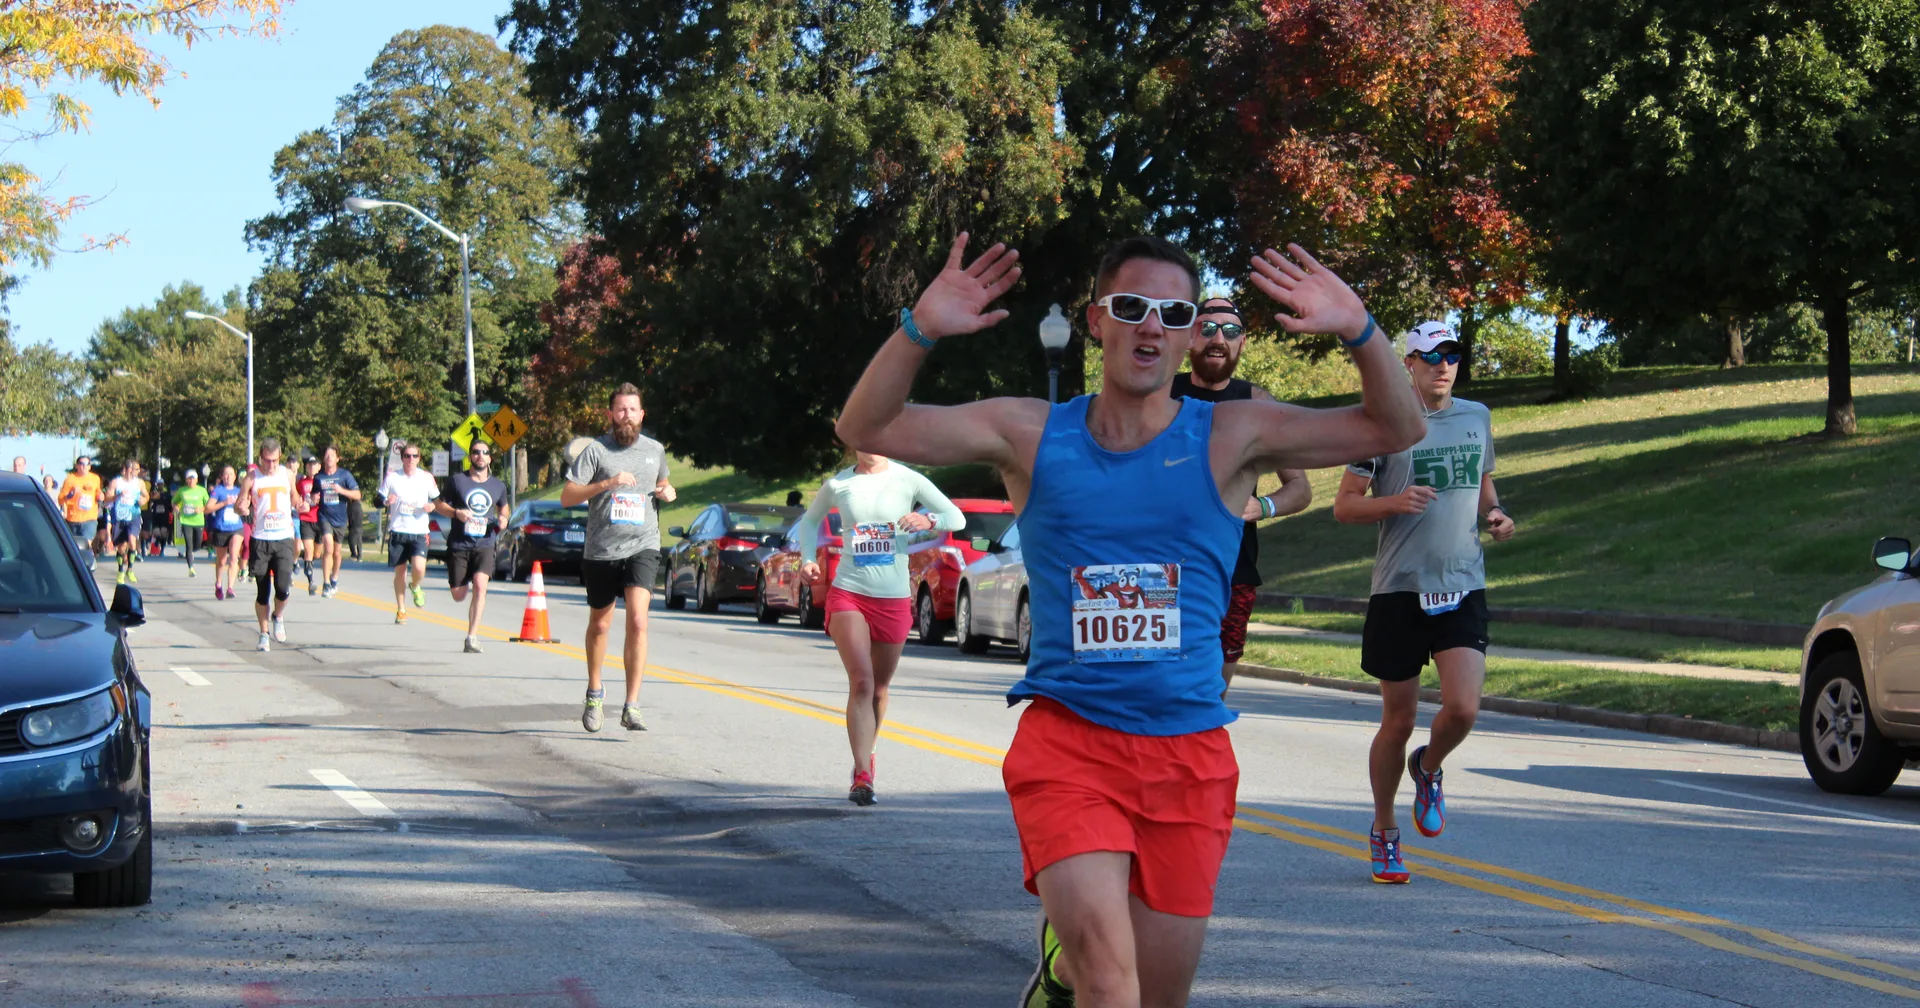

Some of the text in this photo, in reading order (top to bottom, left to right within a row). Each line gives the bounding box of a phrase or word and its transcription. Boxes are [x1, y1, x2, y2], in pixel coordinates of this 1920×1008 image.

[1412, 444, 1482, 459] DIANE GEPPI-AIKENS
[257, 486, 287, 513] T
[855, 541, 890, 553] 10600
[1076, 614, 1167, 645] 10625
